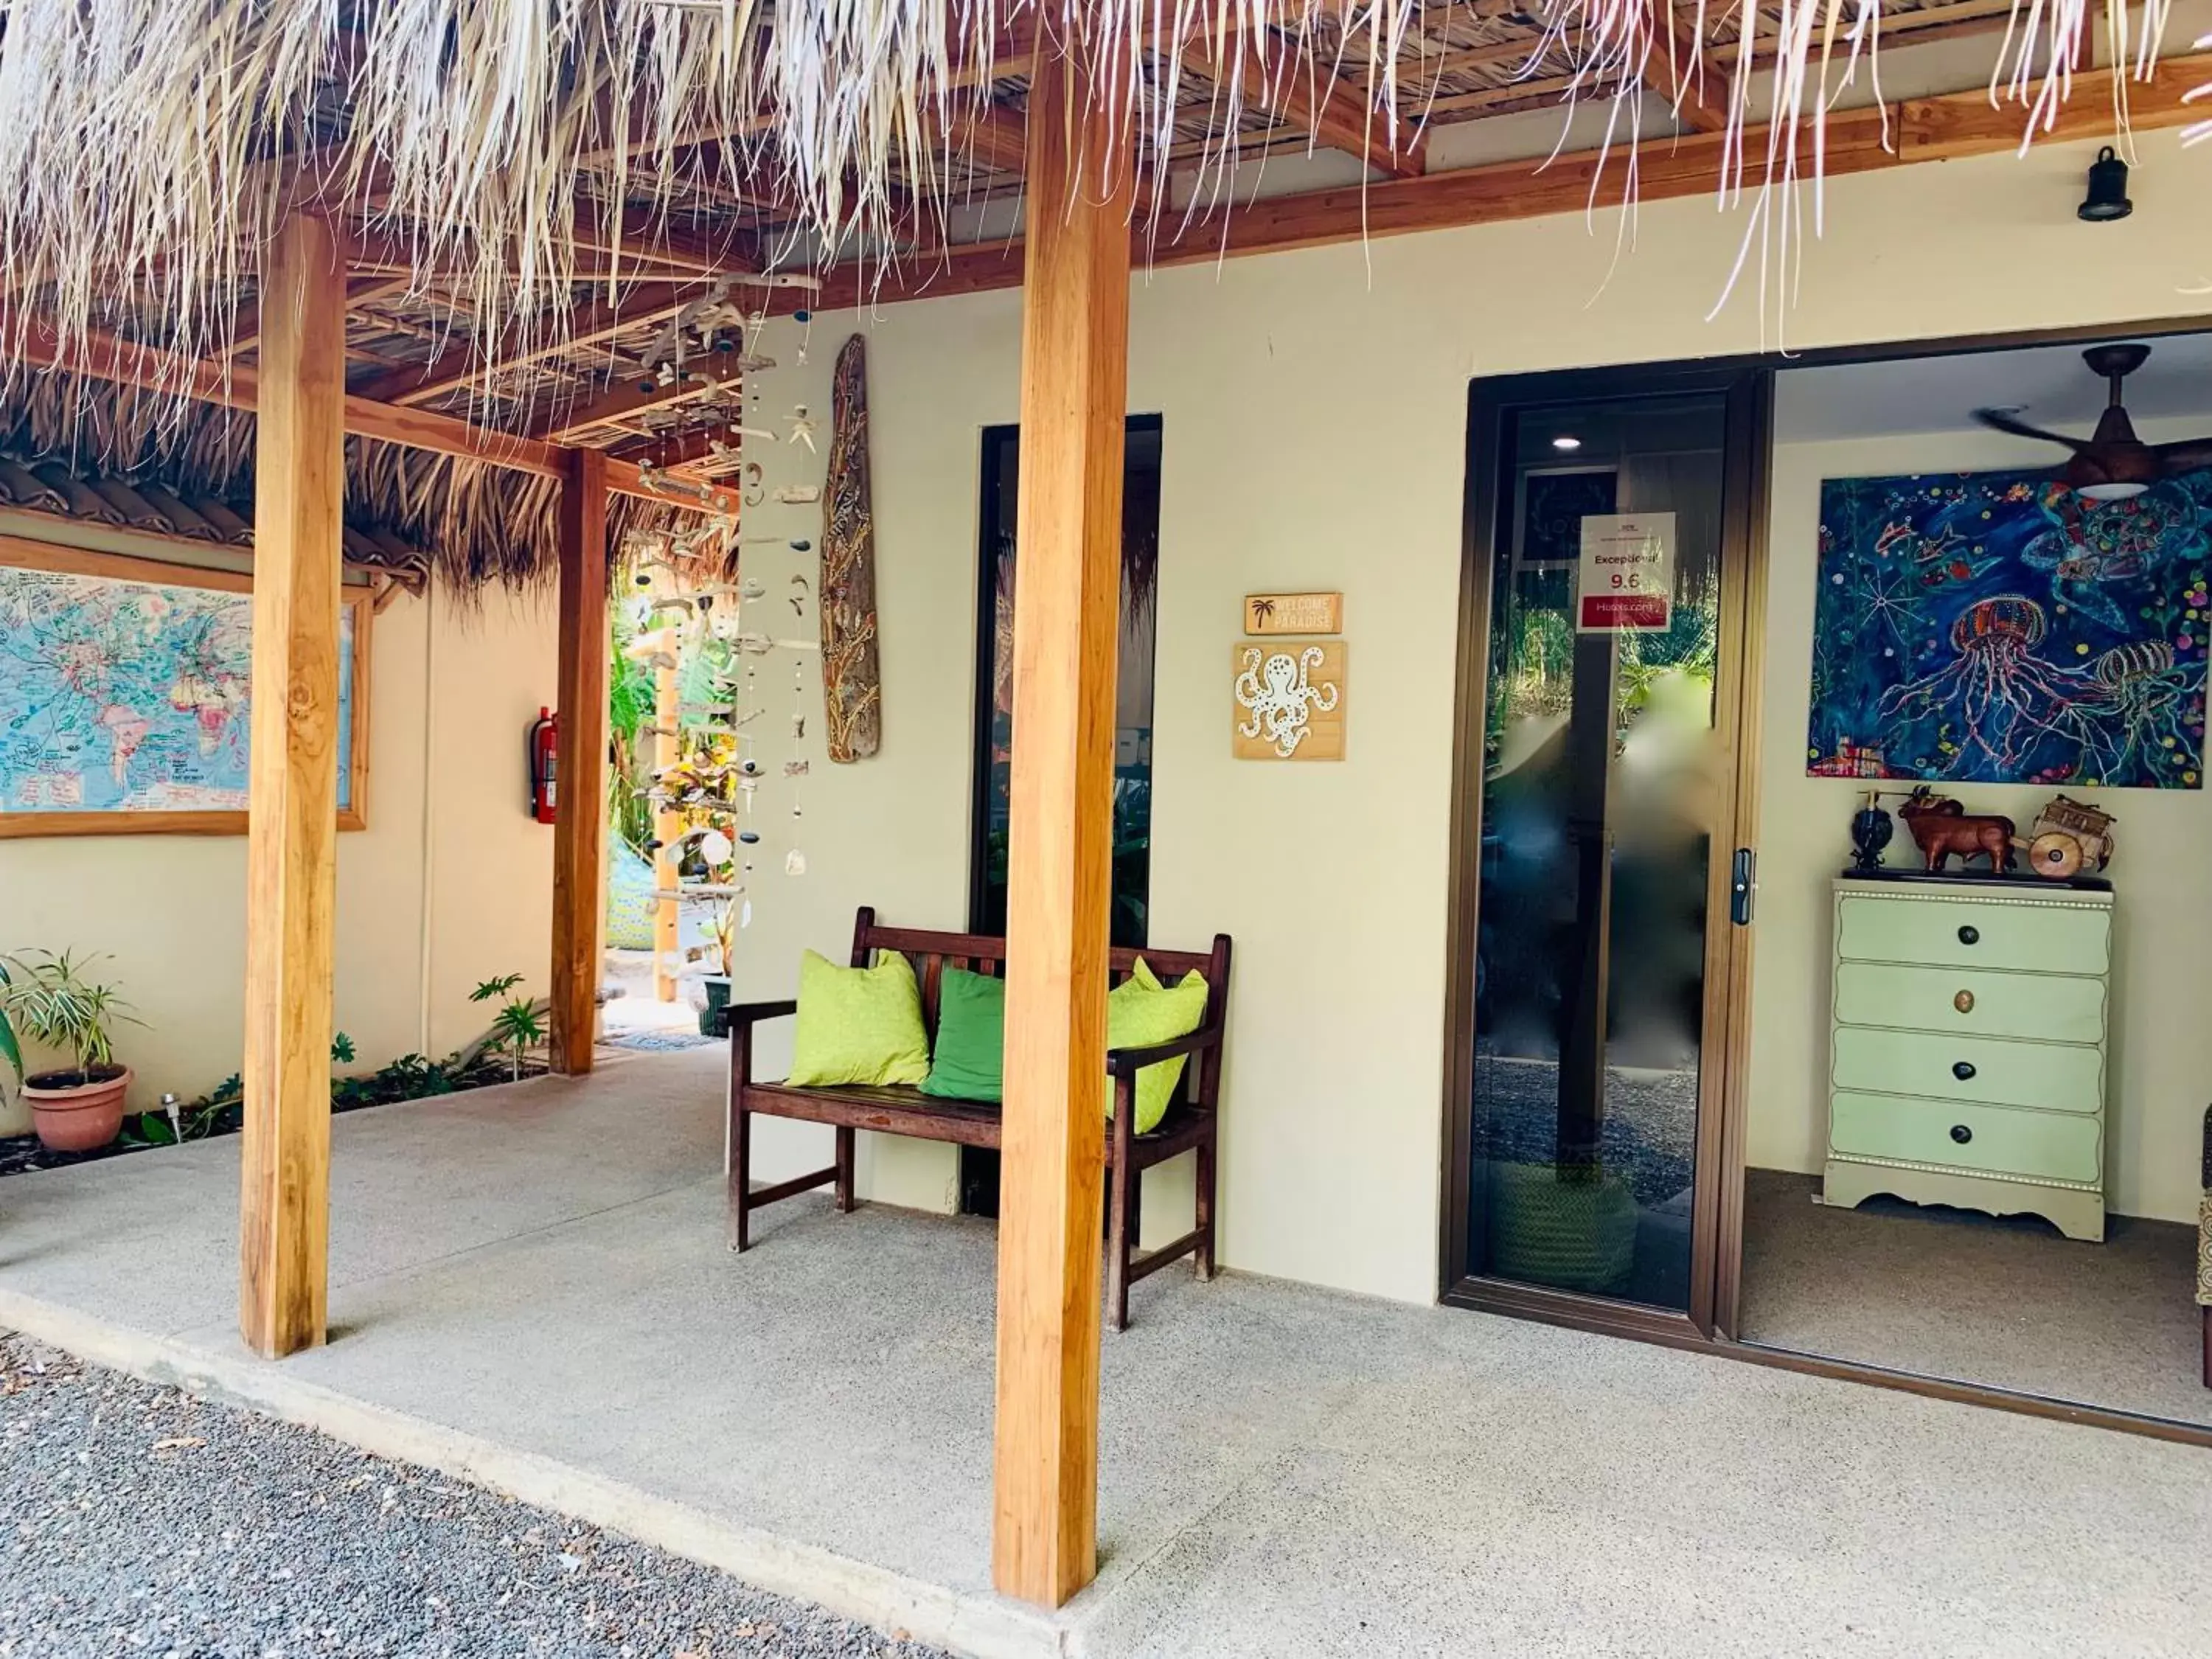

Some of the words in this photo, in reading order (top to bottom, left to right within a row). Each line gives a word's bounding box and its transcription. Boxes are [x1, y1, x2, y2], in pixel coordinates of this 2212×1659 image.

[1594, 554, 1655, 566] Exceptional
[1610, 573, 1641, 589] 9.6
[1275, 597, 1330, 611] WELCOME
[1274, 614, 1331, 629] PARADISE
